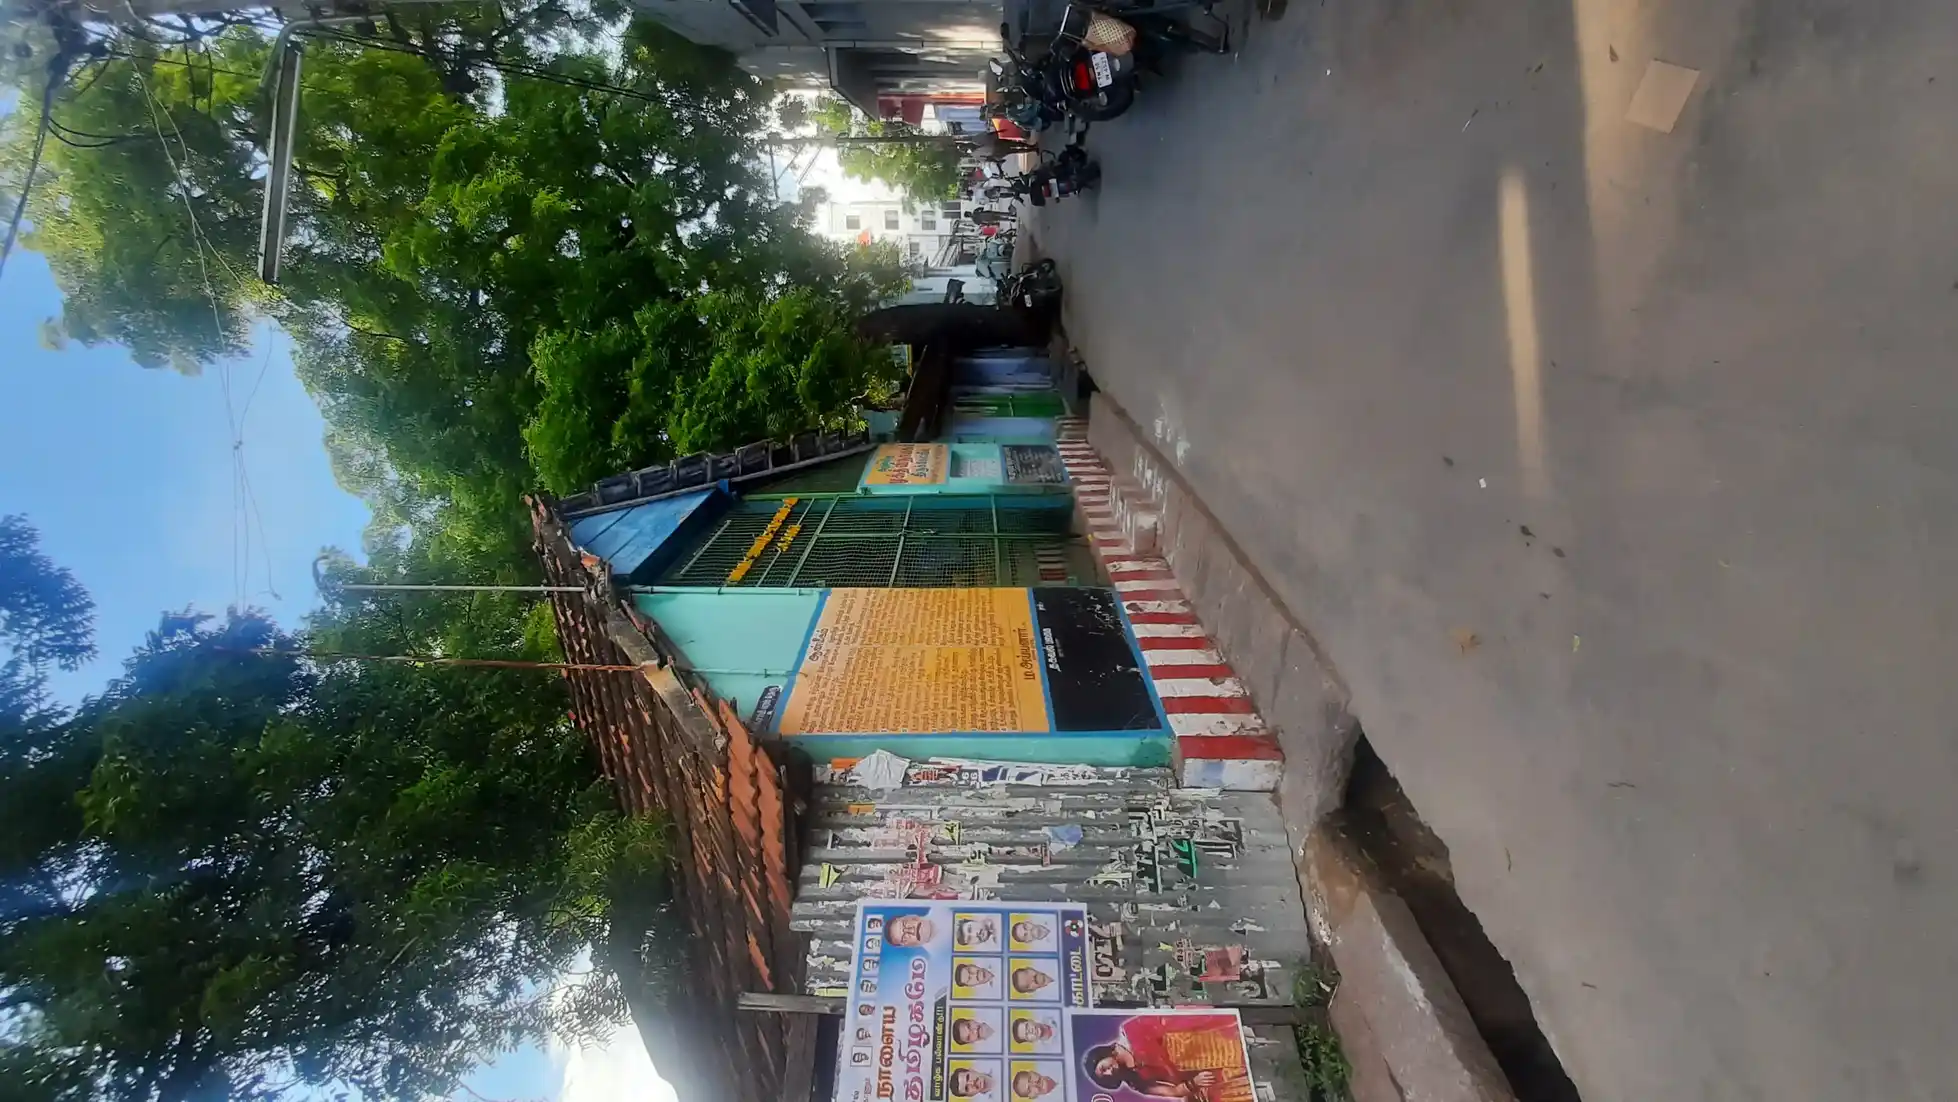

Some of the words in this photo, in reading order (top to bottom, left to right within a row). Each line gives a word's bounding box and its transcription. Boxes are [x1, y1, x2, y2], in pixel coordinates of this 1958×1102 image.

[1068, 946, 1085, 1008] காட்டை
[876, 1005, 896, 1102] நாளைய
[896, 957, 930, 1102] தமிழகமே
[933, 1066, 943, 1097] வாழ்க
